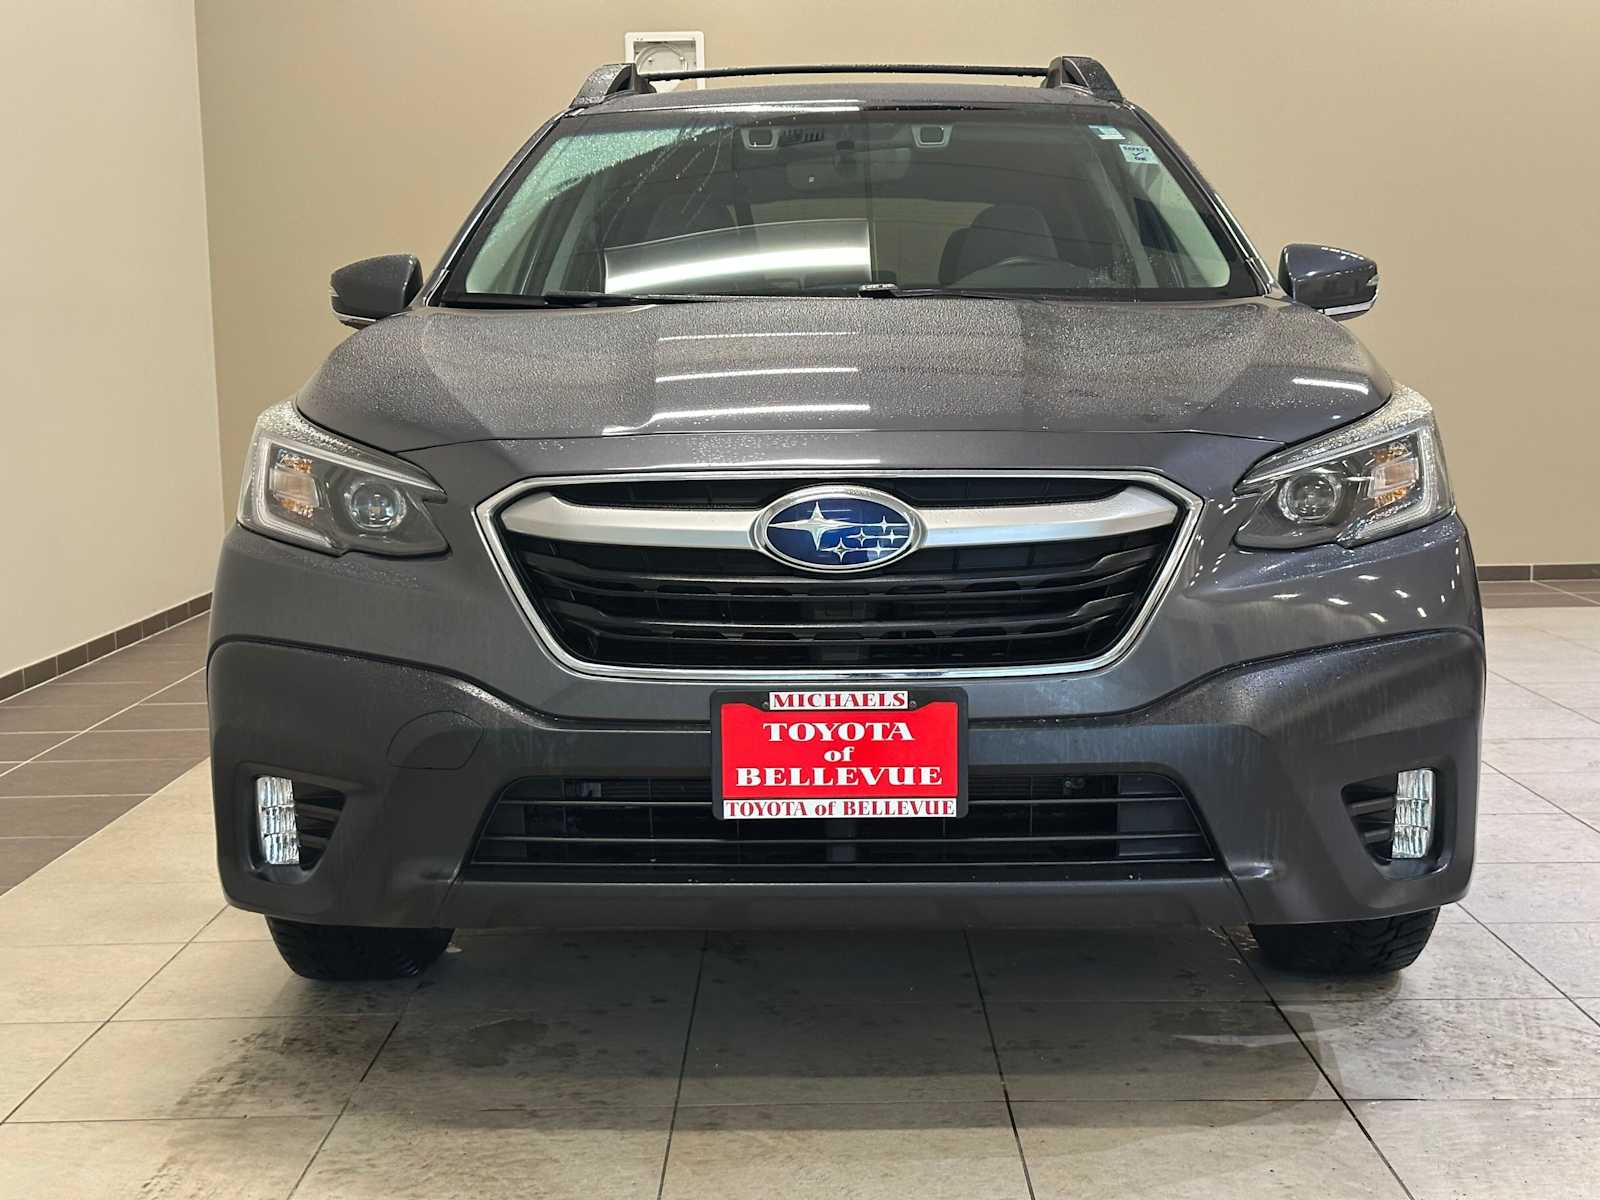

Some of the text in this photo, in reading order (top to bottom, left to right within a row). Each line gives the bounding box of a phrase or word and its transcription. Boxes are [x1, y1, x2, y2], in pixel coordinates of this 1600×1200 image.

[773, 692, 906, 708] MICHAELS
[763, 722, 914, 742] TOYOTA
[823, 746, 855, 762] of
[736, 767, 942, 787] BELLEVUE
[726, 800, 955, 816] TOYOTA of BELLEVUE
